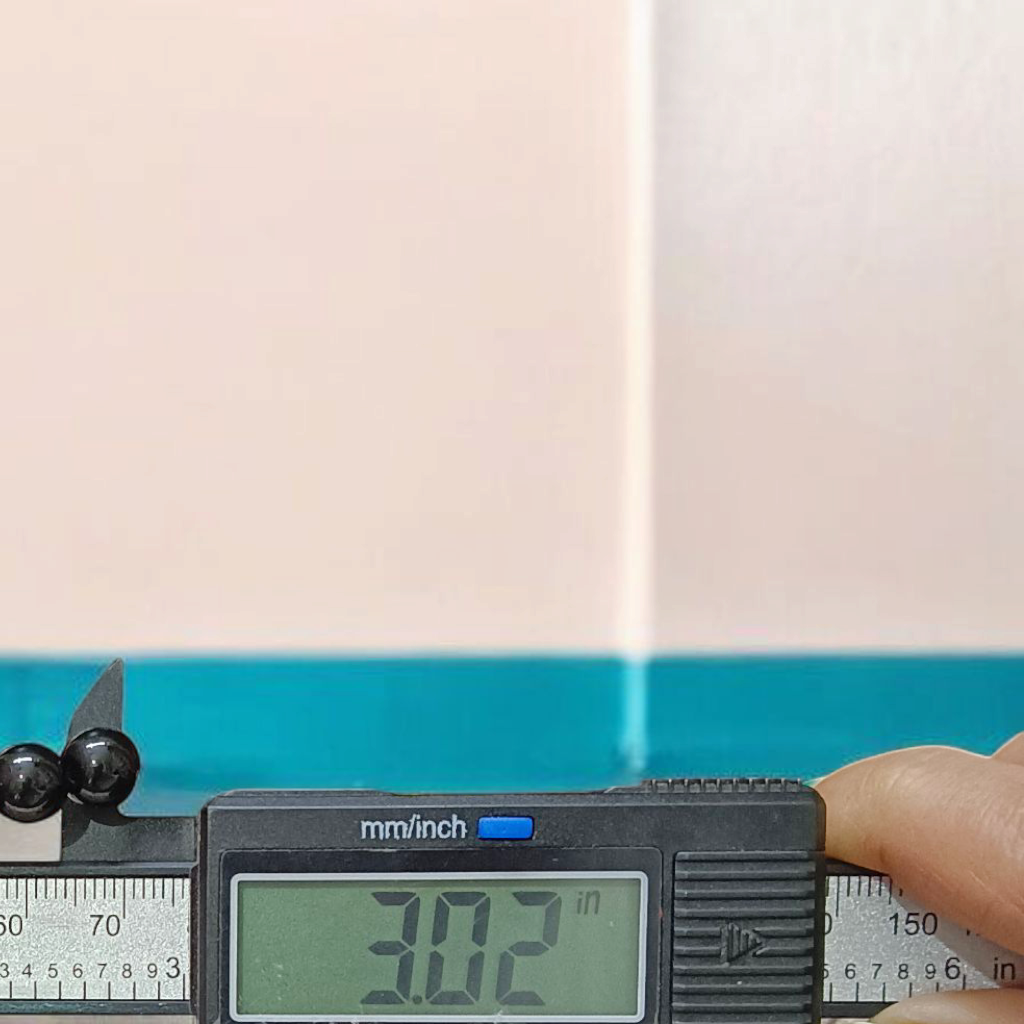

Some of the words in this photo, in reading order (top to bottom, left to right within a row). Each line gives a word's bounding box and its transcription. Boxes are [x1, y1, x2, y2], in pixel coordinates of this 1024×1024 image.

[361, 814, 467, 841] mm/inch
[90, 915, 121, 936] 70
[889, 913, 938, 935] 150
[360, 891, 561, 1006] 3.02
[577, 891, 600, 916] in
[0, 963, 10, 978] 3
[21, 963, 32, 978] 4
[47, 963, 58, 978] 5
[72, 963, 83, 978] 6
[97, 963, 108, 978] 7
[122, 963, 132, 978] 8
[147, 963, 157, 978] 9
[166, 958, 180, 979] 3
[845, 964, 856, 979] 6
[872, 964, 882, 979] 7
[898, 964, 909, 979] 8
[925, 964, 936, 979] 9
[945, 957, 960, 979] 6
[994, 957, 1015, 979] in
